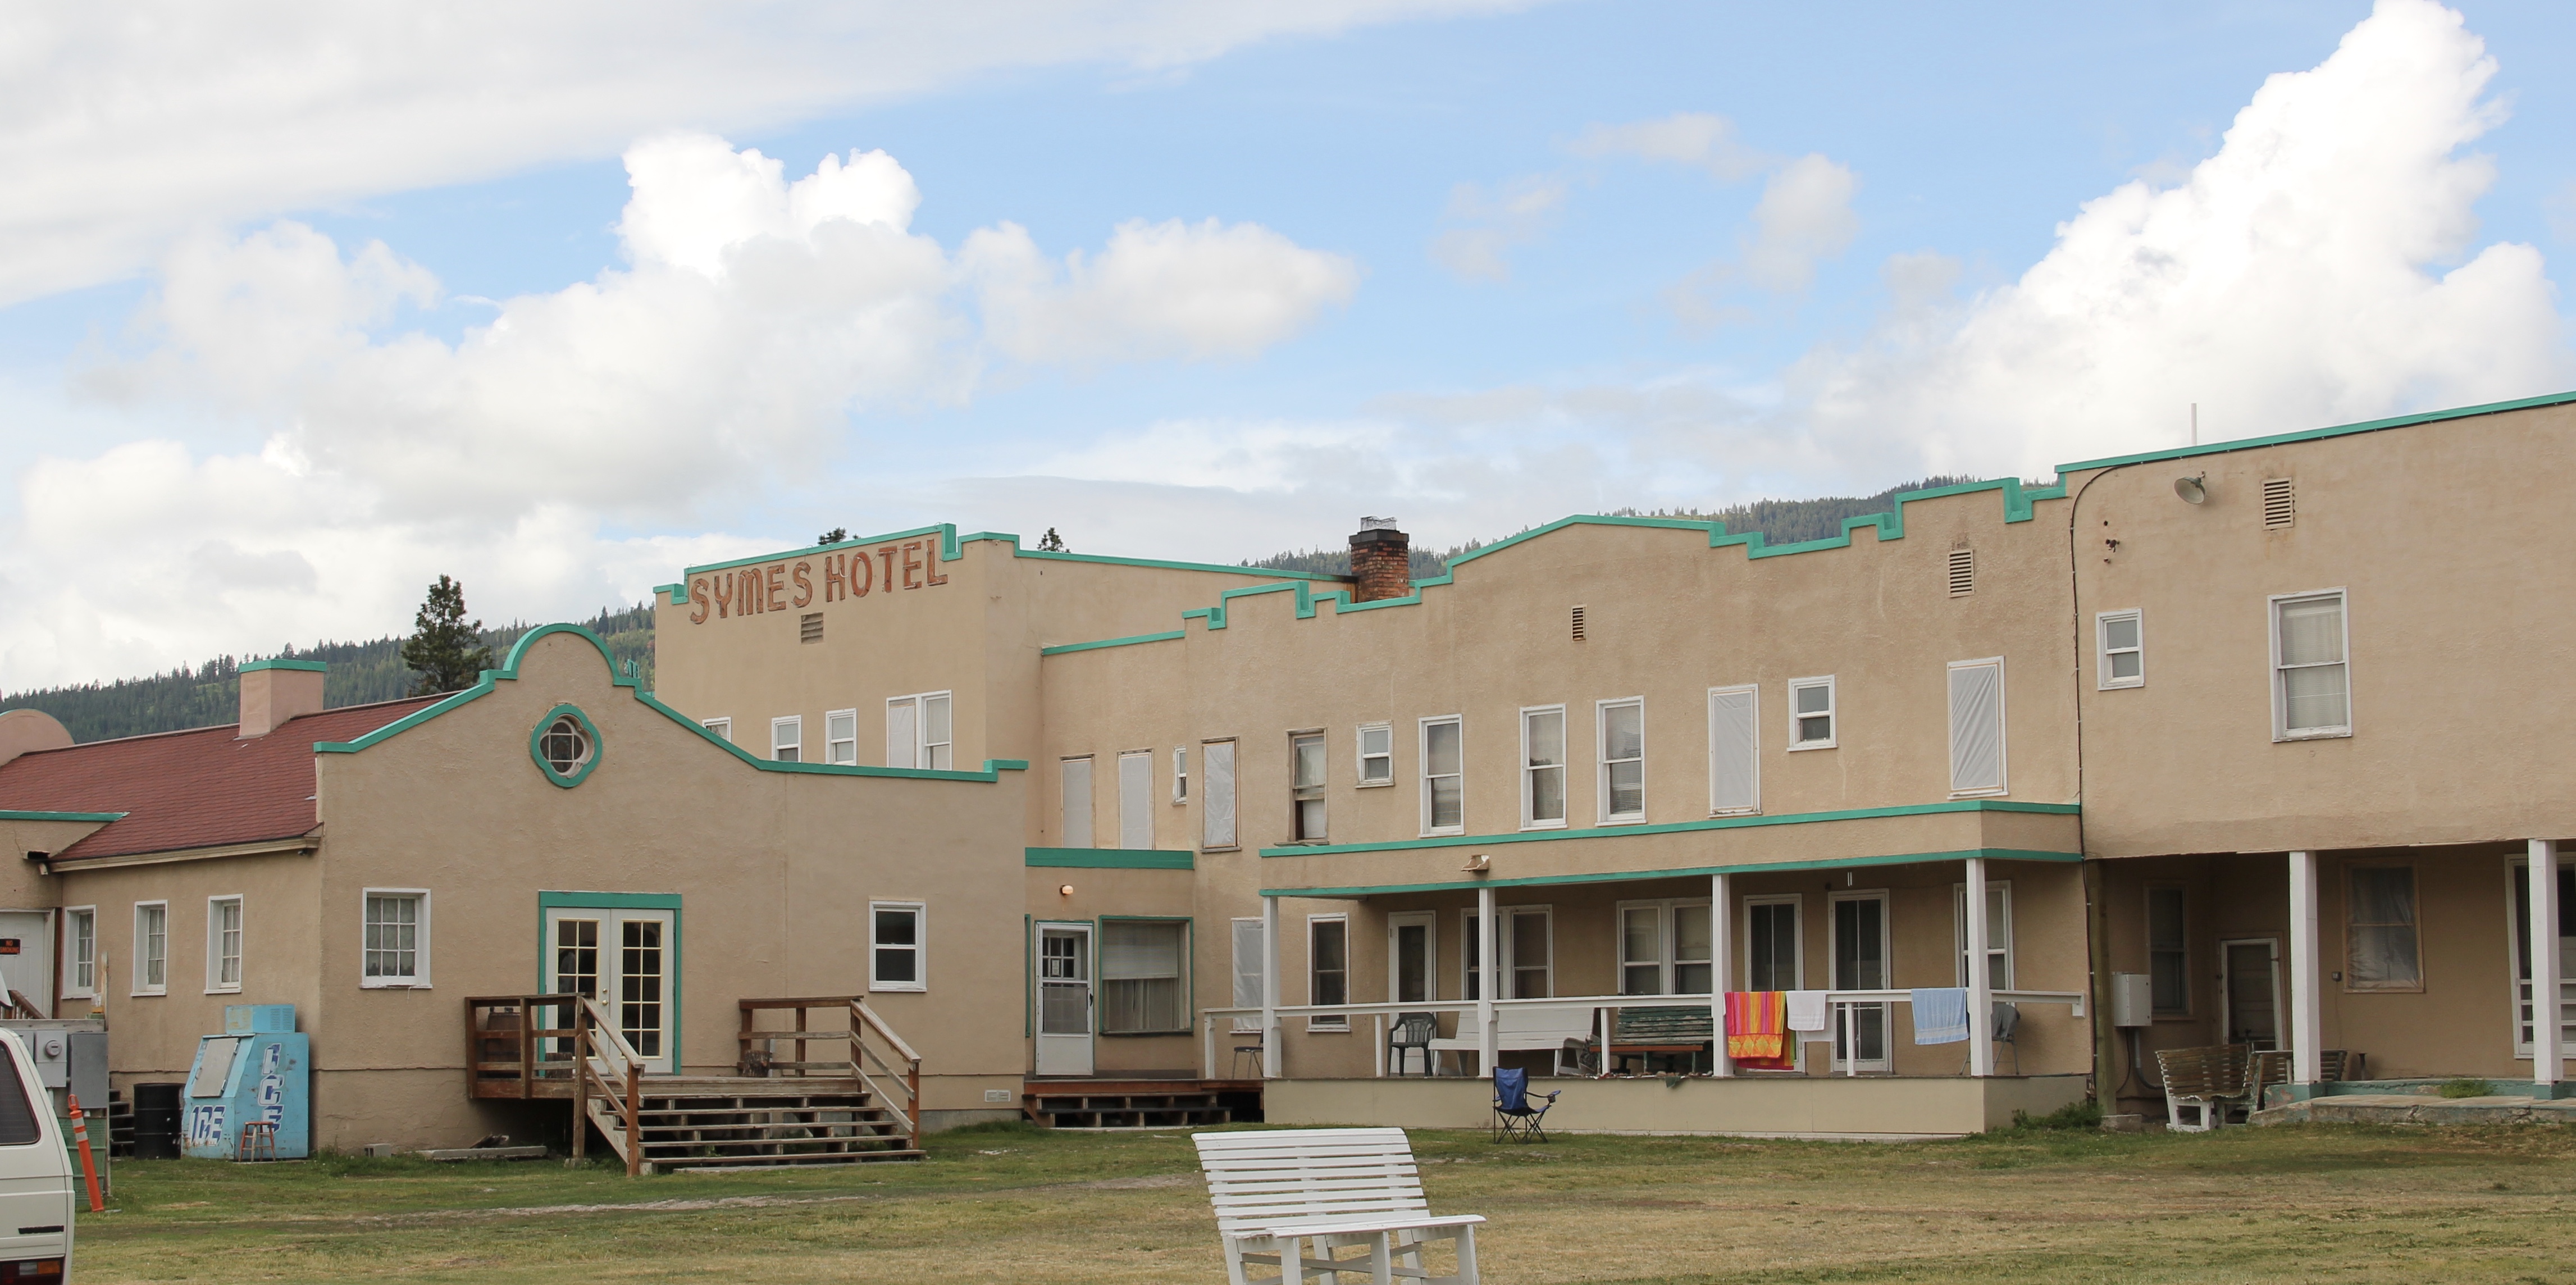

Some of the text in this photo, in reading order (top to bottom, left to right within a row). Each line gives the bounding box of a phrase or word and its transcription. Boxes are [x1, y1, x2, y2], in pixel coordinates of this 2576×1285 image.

[690, 539, 948, 625] SYMES HOTEL
[188, 1105, 226, 1147] ICE
[258, 1043, 284, 1133] ICE
